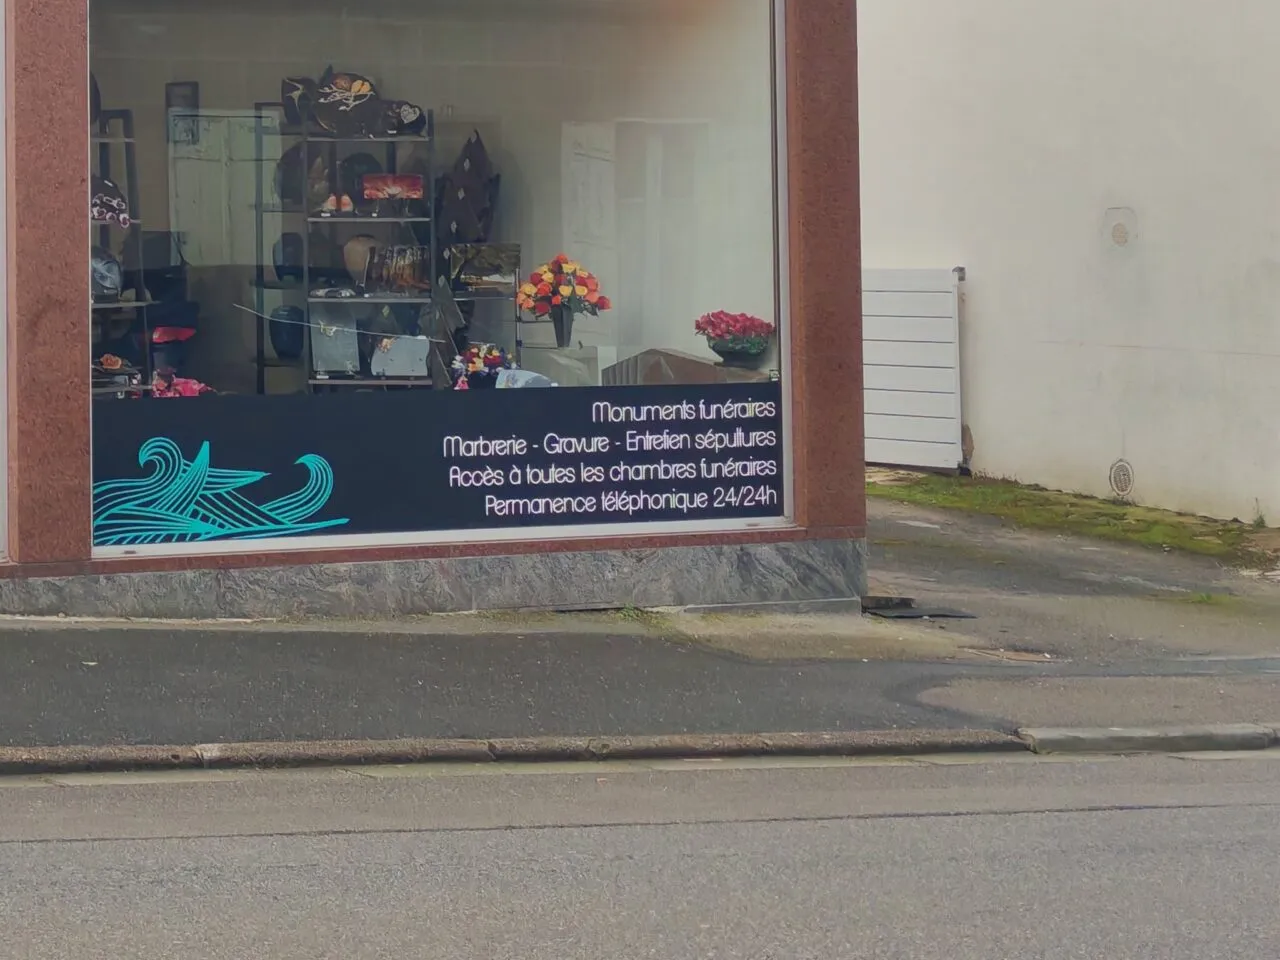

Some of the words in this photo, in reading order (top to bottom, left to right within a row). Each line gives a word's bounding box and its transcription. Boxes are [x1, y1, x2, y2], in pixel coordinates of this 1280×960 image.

[592, 399, 696, 423] Monuments
[699, 397, 776, 420] funéraires
[443, 433, 528, 458] Marbrerie
[543, 432, 610, 455] Gravure
[626, 429, 691, 452] Entretien
[695, 426, 777, 454] sépultures
[449, 464, 504, 488] Accès
[508, 463, 522, 485] à
[526, 462, 576, 485] toutes
[581, 461, 605, 483] les
[609, 459, 697, 482] chambres
[700, 455, 777, 479] funéraires
[485, 494, 597, 517] Permanence
[601, 487, 709, 516] téléphonique
[713, 485, 777, 508] 24/24h
